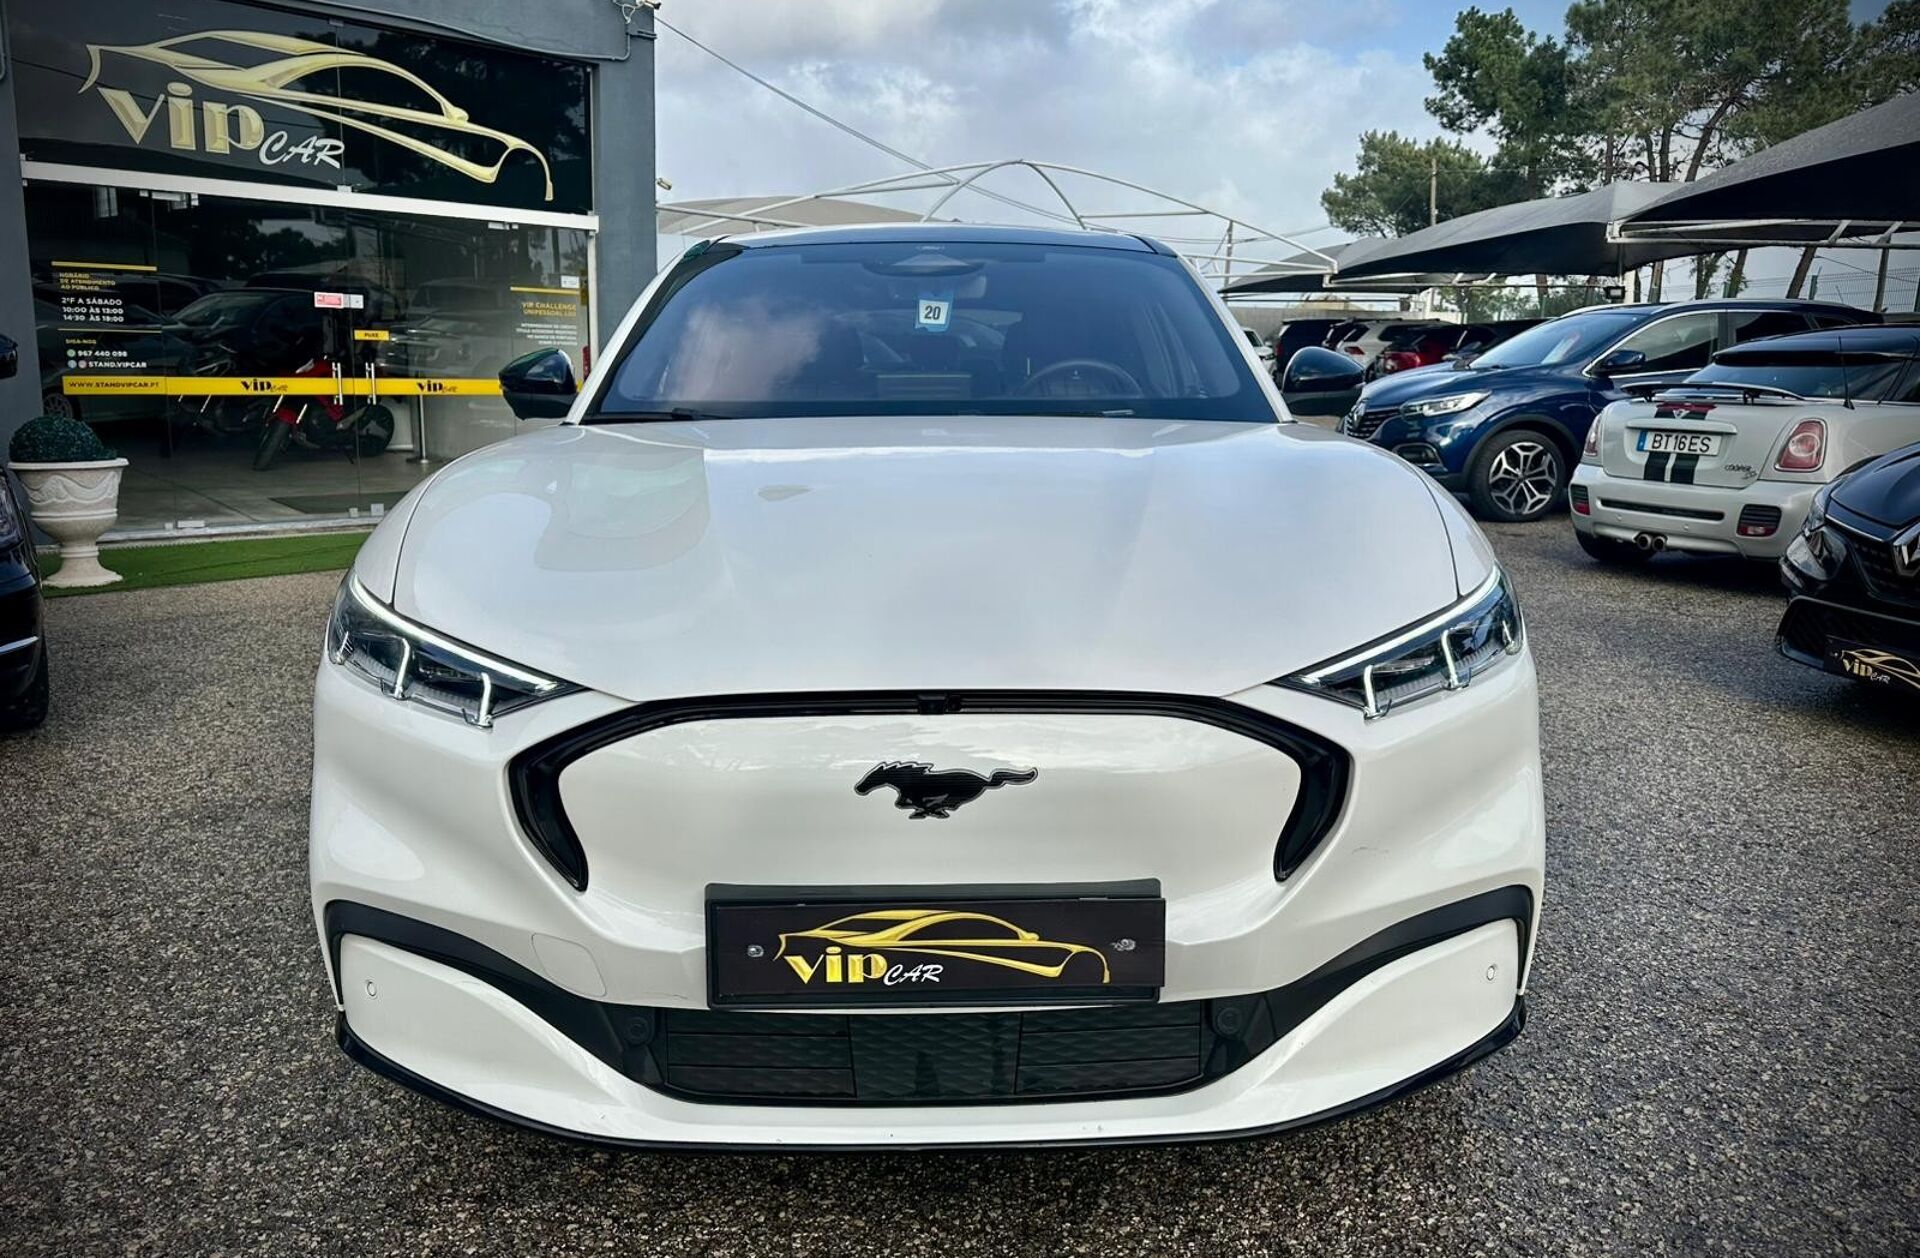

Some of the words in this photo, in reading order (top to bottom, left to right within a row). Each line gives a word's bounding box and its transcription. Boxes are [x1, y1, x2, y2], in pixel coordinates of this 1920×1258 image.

[259, 131, 345, 169] CAR
[86, 297, 122, 305] SÁBADO
[924, 305, 941, 320] 20
[883, 963, 944, 985] CAR
